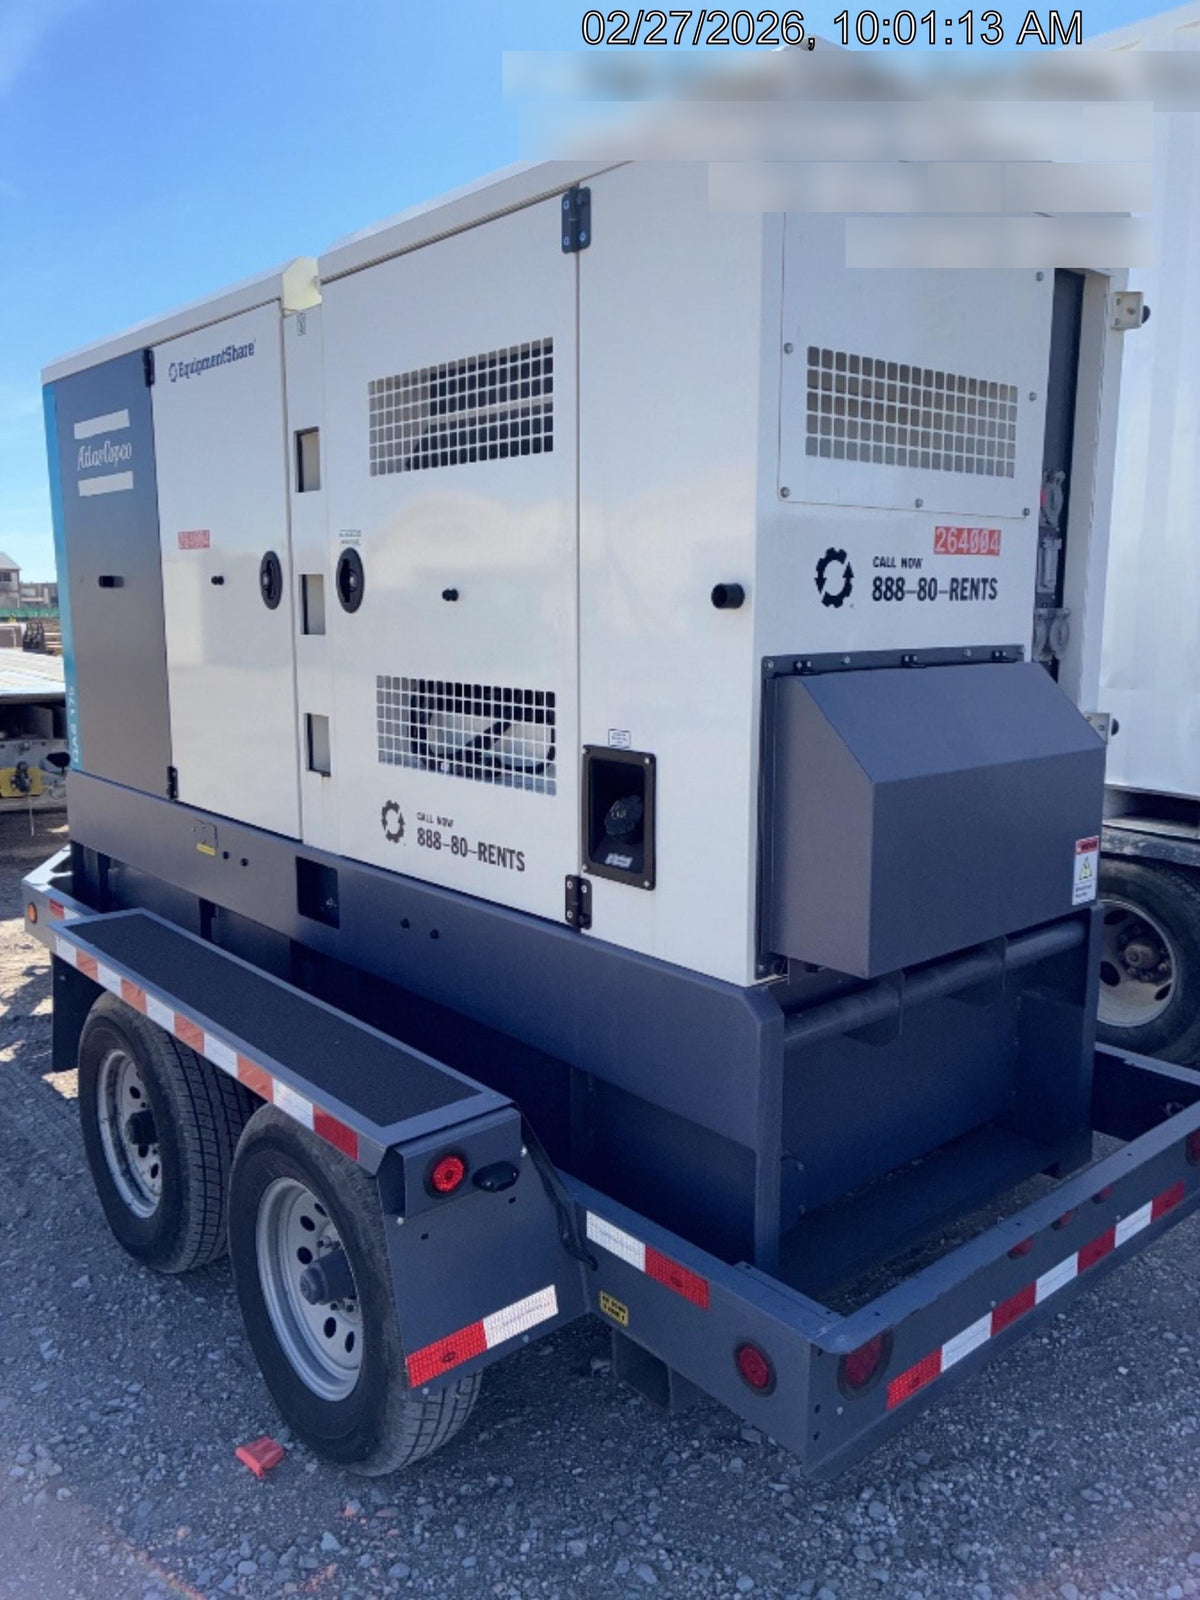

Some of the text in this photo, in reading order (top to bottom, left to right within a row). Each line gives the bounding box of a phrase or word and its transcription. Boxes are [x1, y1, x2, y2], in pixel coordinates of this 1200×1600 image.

[178, 343, 255, 379] EquipmentShare
[872, 556, 923, 569] CALL NOW
[872, 576, 998, 602] 888-80-RENTS
[417, 827, 526, 872] 888-80-RENTS
